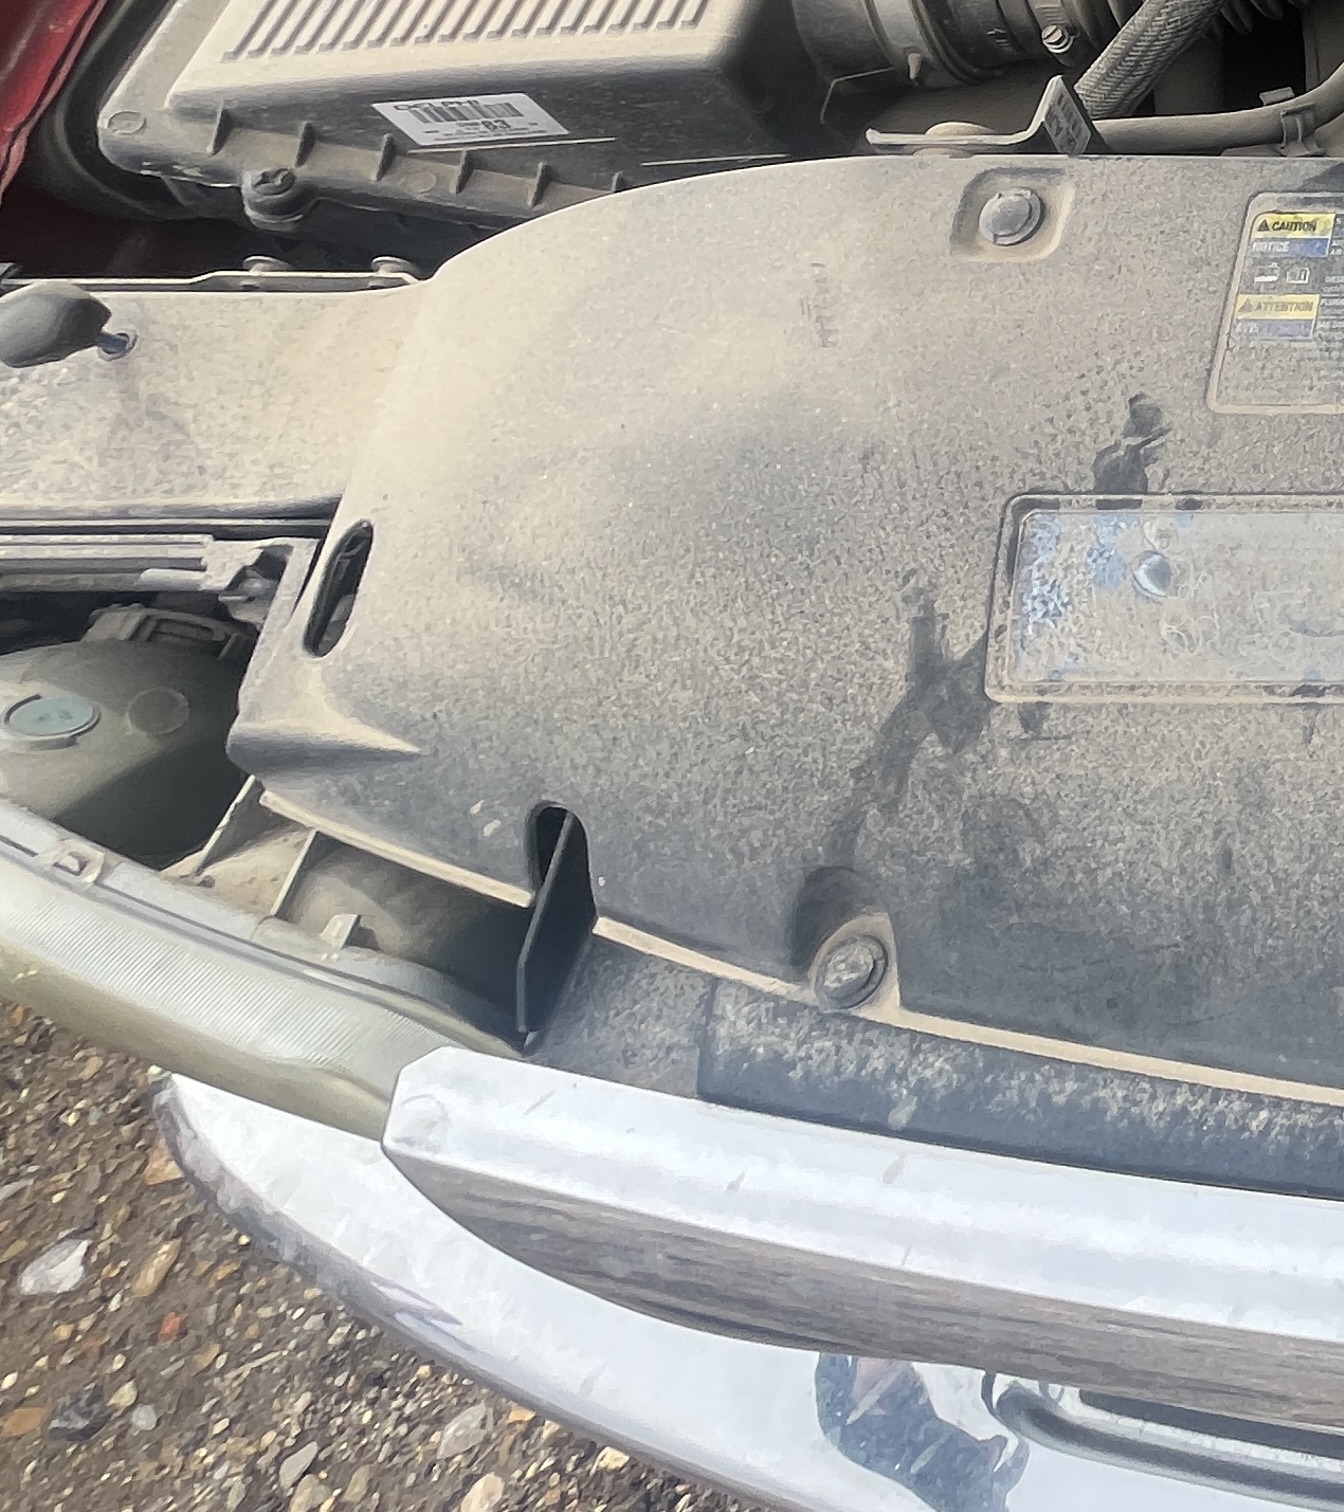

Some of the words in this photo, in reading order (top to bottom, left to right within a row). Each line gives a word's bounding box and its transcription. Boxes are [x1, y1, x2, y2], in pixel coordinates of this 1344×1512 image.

[1271, 220, 1318, 232] CAUTION
[1252, 240, 1291, 253] NOTICE
[1254, 300, 1315, 312] ATTENTION
